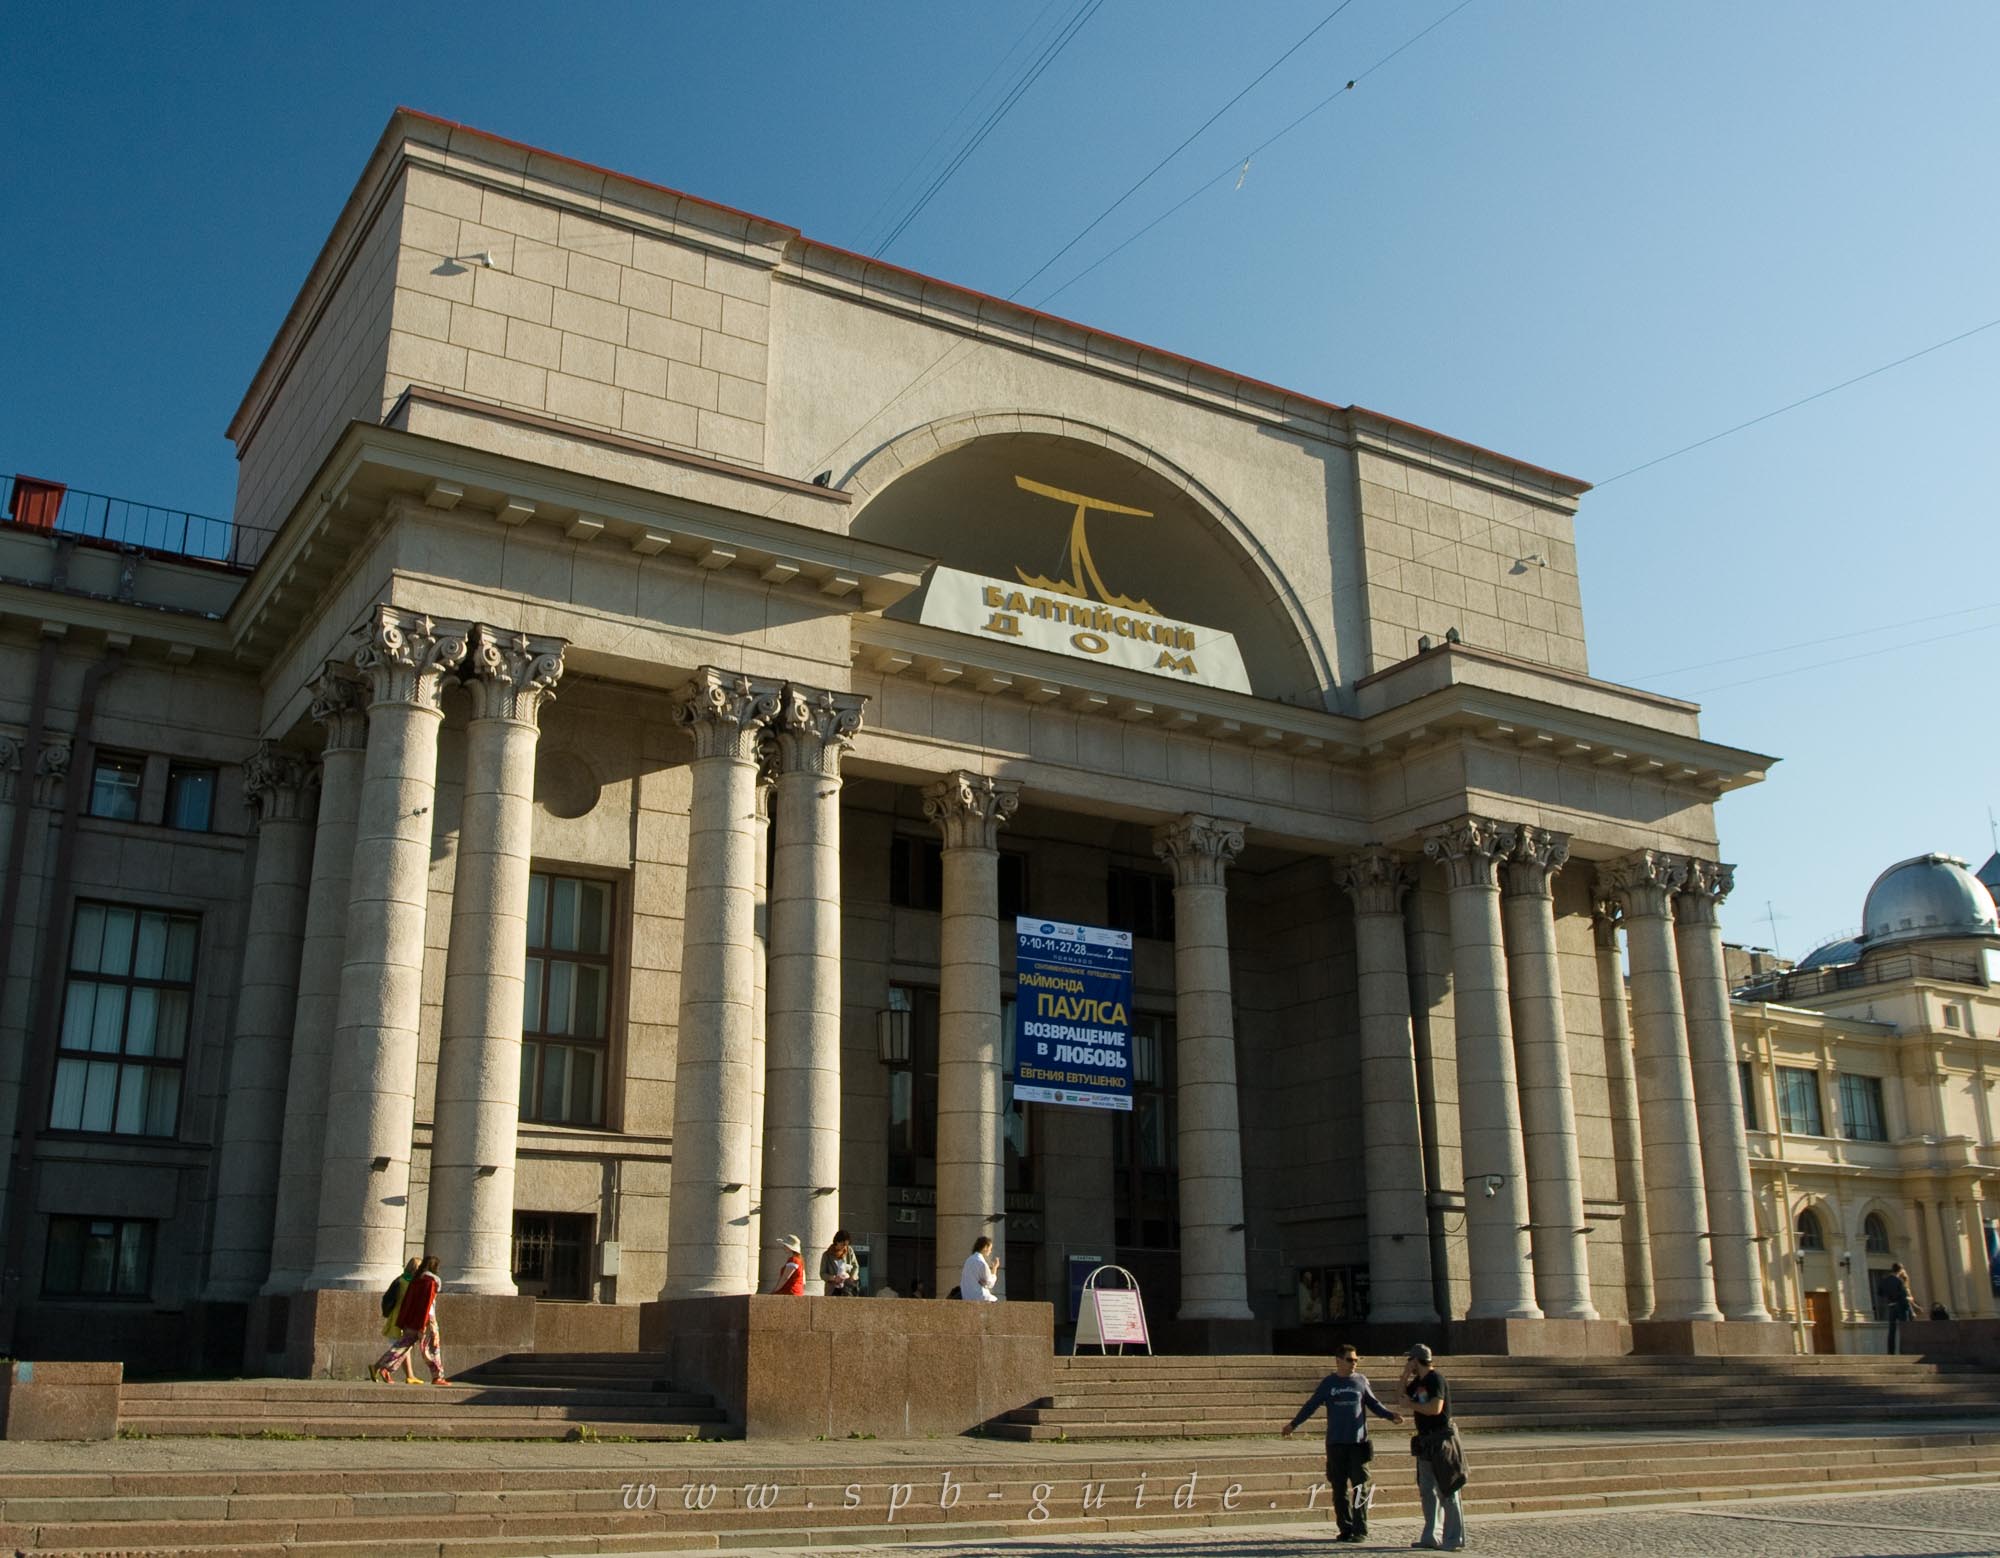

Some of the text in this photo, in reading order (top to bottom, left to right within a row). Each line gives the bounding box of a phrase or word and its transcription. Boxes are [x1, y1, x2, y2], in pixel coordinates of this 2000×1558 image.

[982, 585, 1195, 650] БАЛТИЙСКИЙ
[1019, 972, 1084, 993] РАЙМОНДА
[1037, 993, 1128, 1026] ПАУЛСА
[1024, 1021, 1125, 1047] ВОЗВРАЩЕНИЕ
[1037, 1042, 1127, 1069] В ЛЮБОВЬ
[1020, 1067, 1127, 1089] ЕВГЕНИЯ ЕВТУШЕНКО
